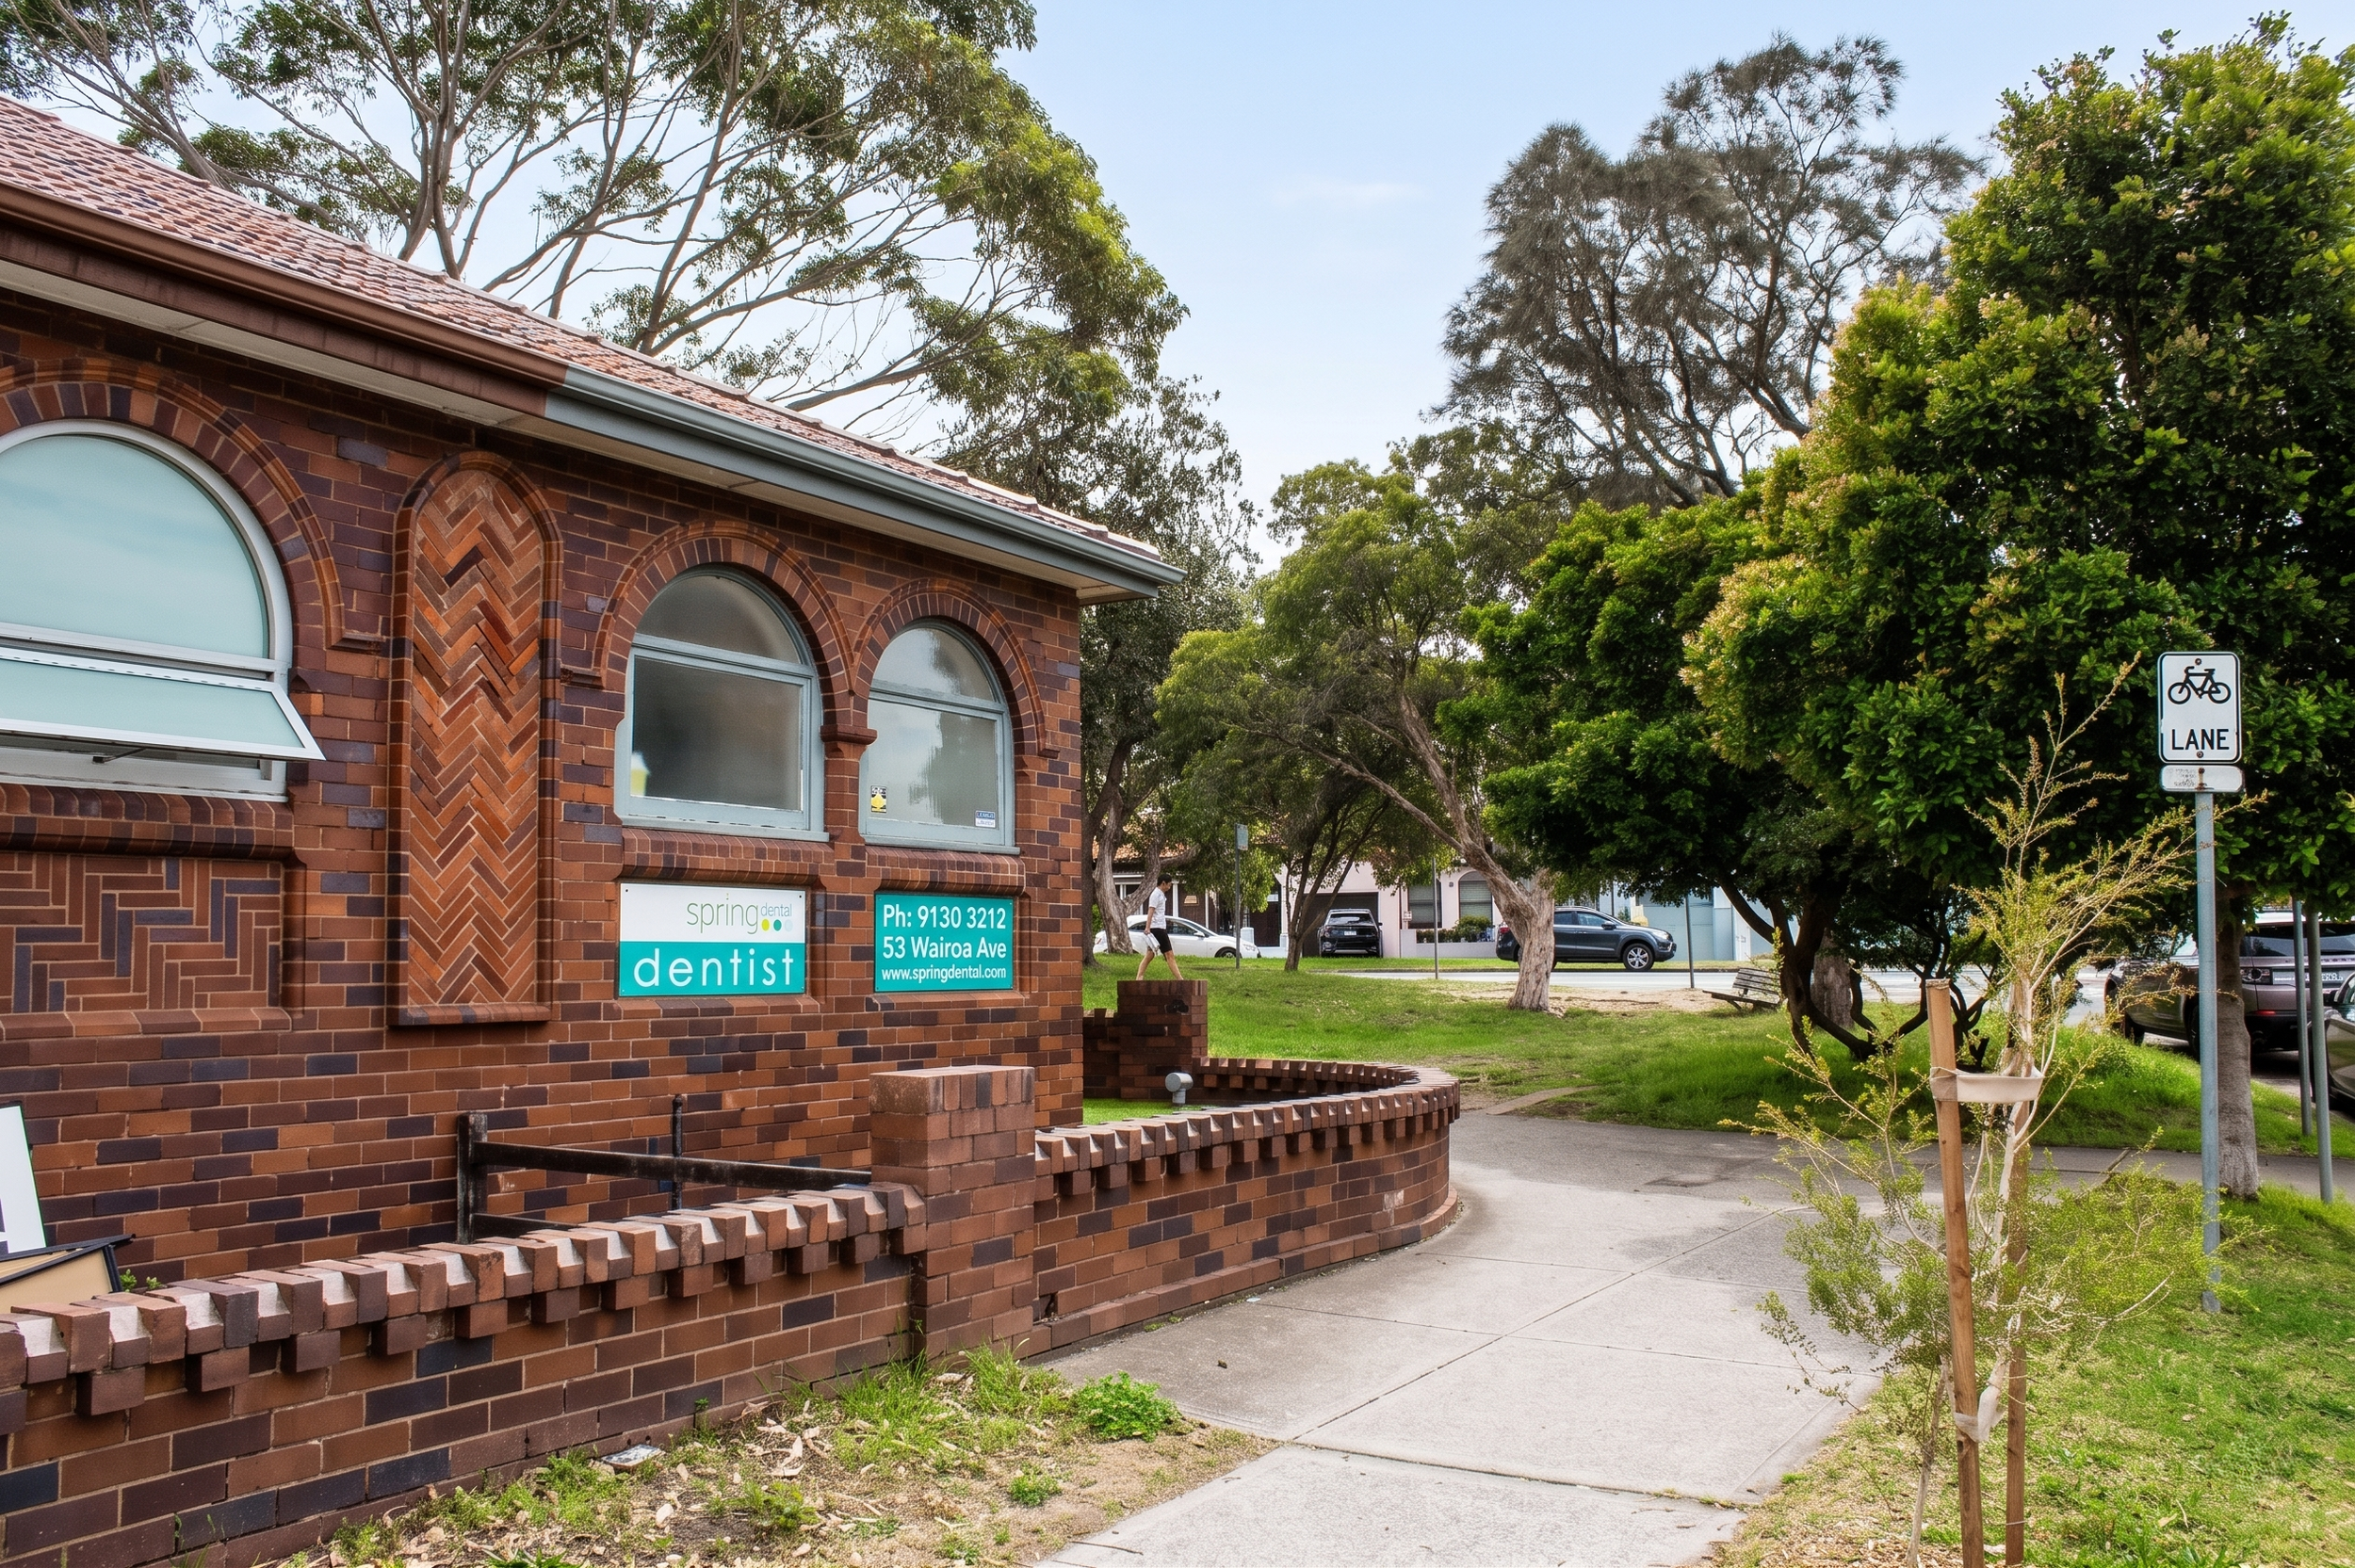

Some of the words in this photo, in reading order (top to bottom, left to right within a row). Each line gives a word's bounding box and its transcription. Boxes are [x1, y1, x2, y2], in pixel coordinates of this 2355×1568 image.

[2171, 729, 2230, 751] LANE
[686, 893, 759, 935] spring
[760, 902, 792, 917] dental
[883, 904, 912, 928] Ph:
[917, 905, 962, 929] 9130
[966, 907, 1006, 929] 3212
[883, 936, 906, 959] 53
[911, 936, 972, 959] Wairoa
[976, 936, 1007, 959] Ave
[633, 947, 794, 988] dentist
[881, 963, 1007, 984] www.springdental.com
